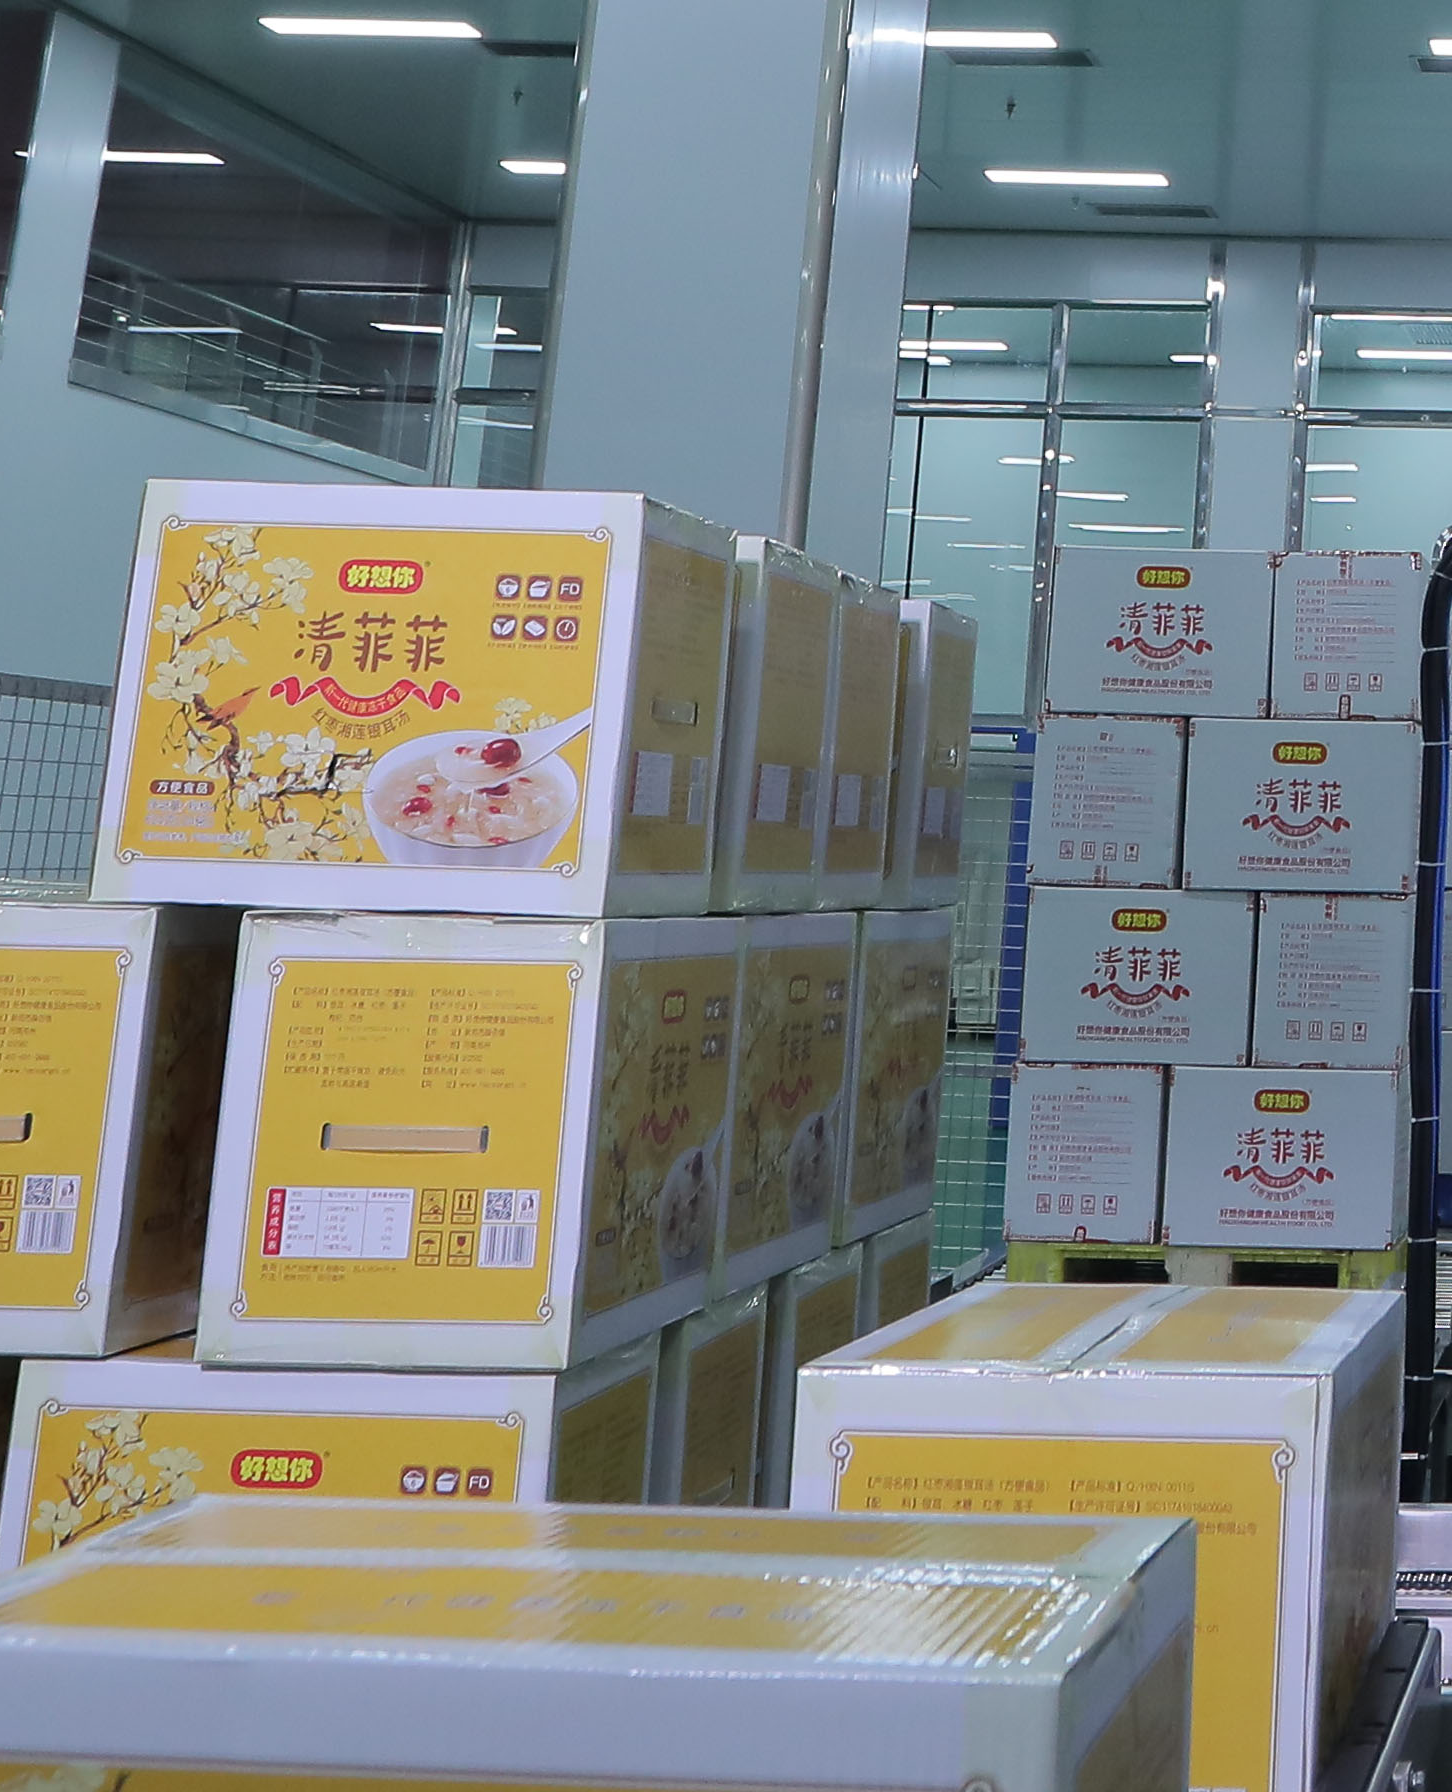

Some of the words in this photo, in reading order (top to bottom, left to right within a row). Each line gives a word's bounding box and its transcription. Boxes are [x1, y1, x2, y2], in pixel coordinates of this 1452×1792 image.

[347, 564, 415, 589] 好想你
[1142, 569, 1185, 585] 好想你
[560, 582, 580, 597] FD
[1119, 602, 1205, 636] 清菲菲
[294, 610, 448, 672] 清菲菲
[1278, 746, 1322, 761] 好想你
[156, 781, 208, 794] 方便食品
[1255, 778, 1342, 813] 清菲菲
[1117, 913, 1162, 928] 好想你
[1094, 946, 1182, 982] 清菲菲
[1259, 1093, 1305, 1109] 好想你
[1236, 1127, 1325, 1164] 清菲菲
[238, 1454, 315, 1484] 好想你
[468, 1474, 490, 1490] FD
